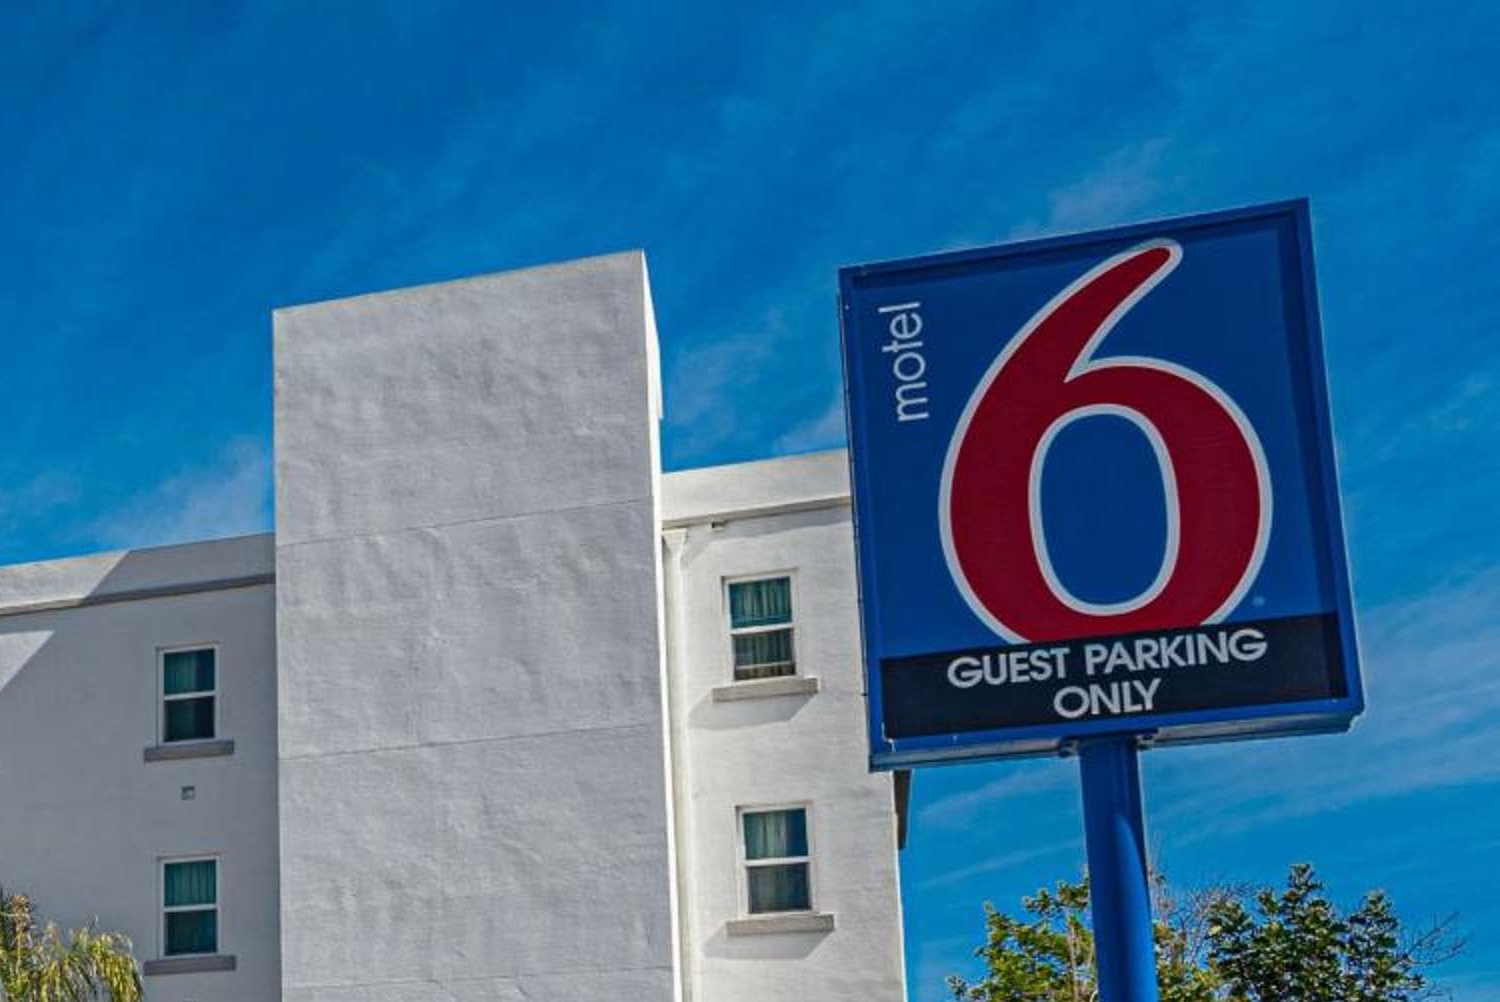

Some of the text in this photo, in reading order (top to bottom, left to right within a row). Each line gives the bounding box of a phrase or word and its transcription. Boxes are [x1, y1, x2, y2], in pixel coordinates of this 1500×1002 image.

[878, 301, 930, 422] motel
[937, 237, 1274, 645] 6
[947, 628, 1268, 689] GUEST PARKING
[1052, 677, 1163, 719] ONLY
